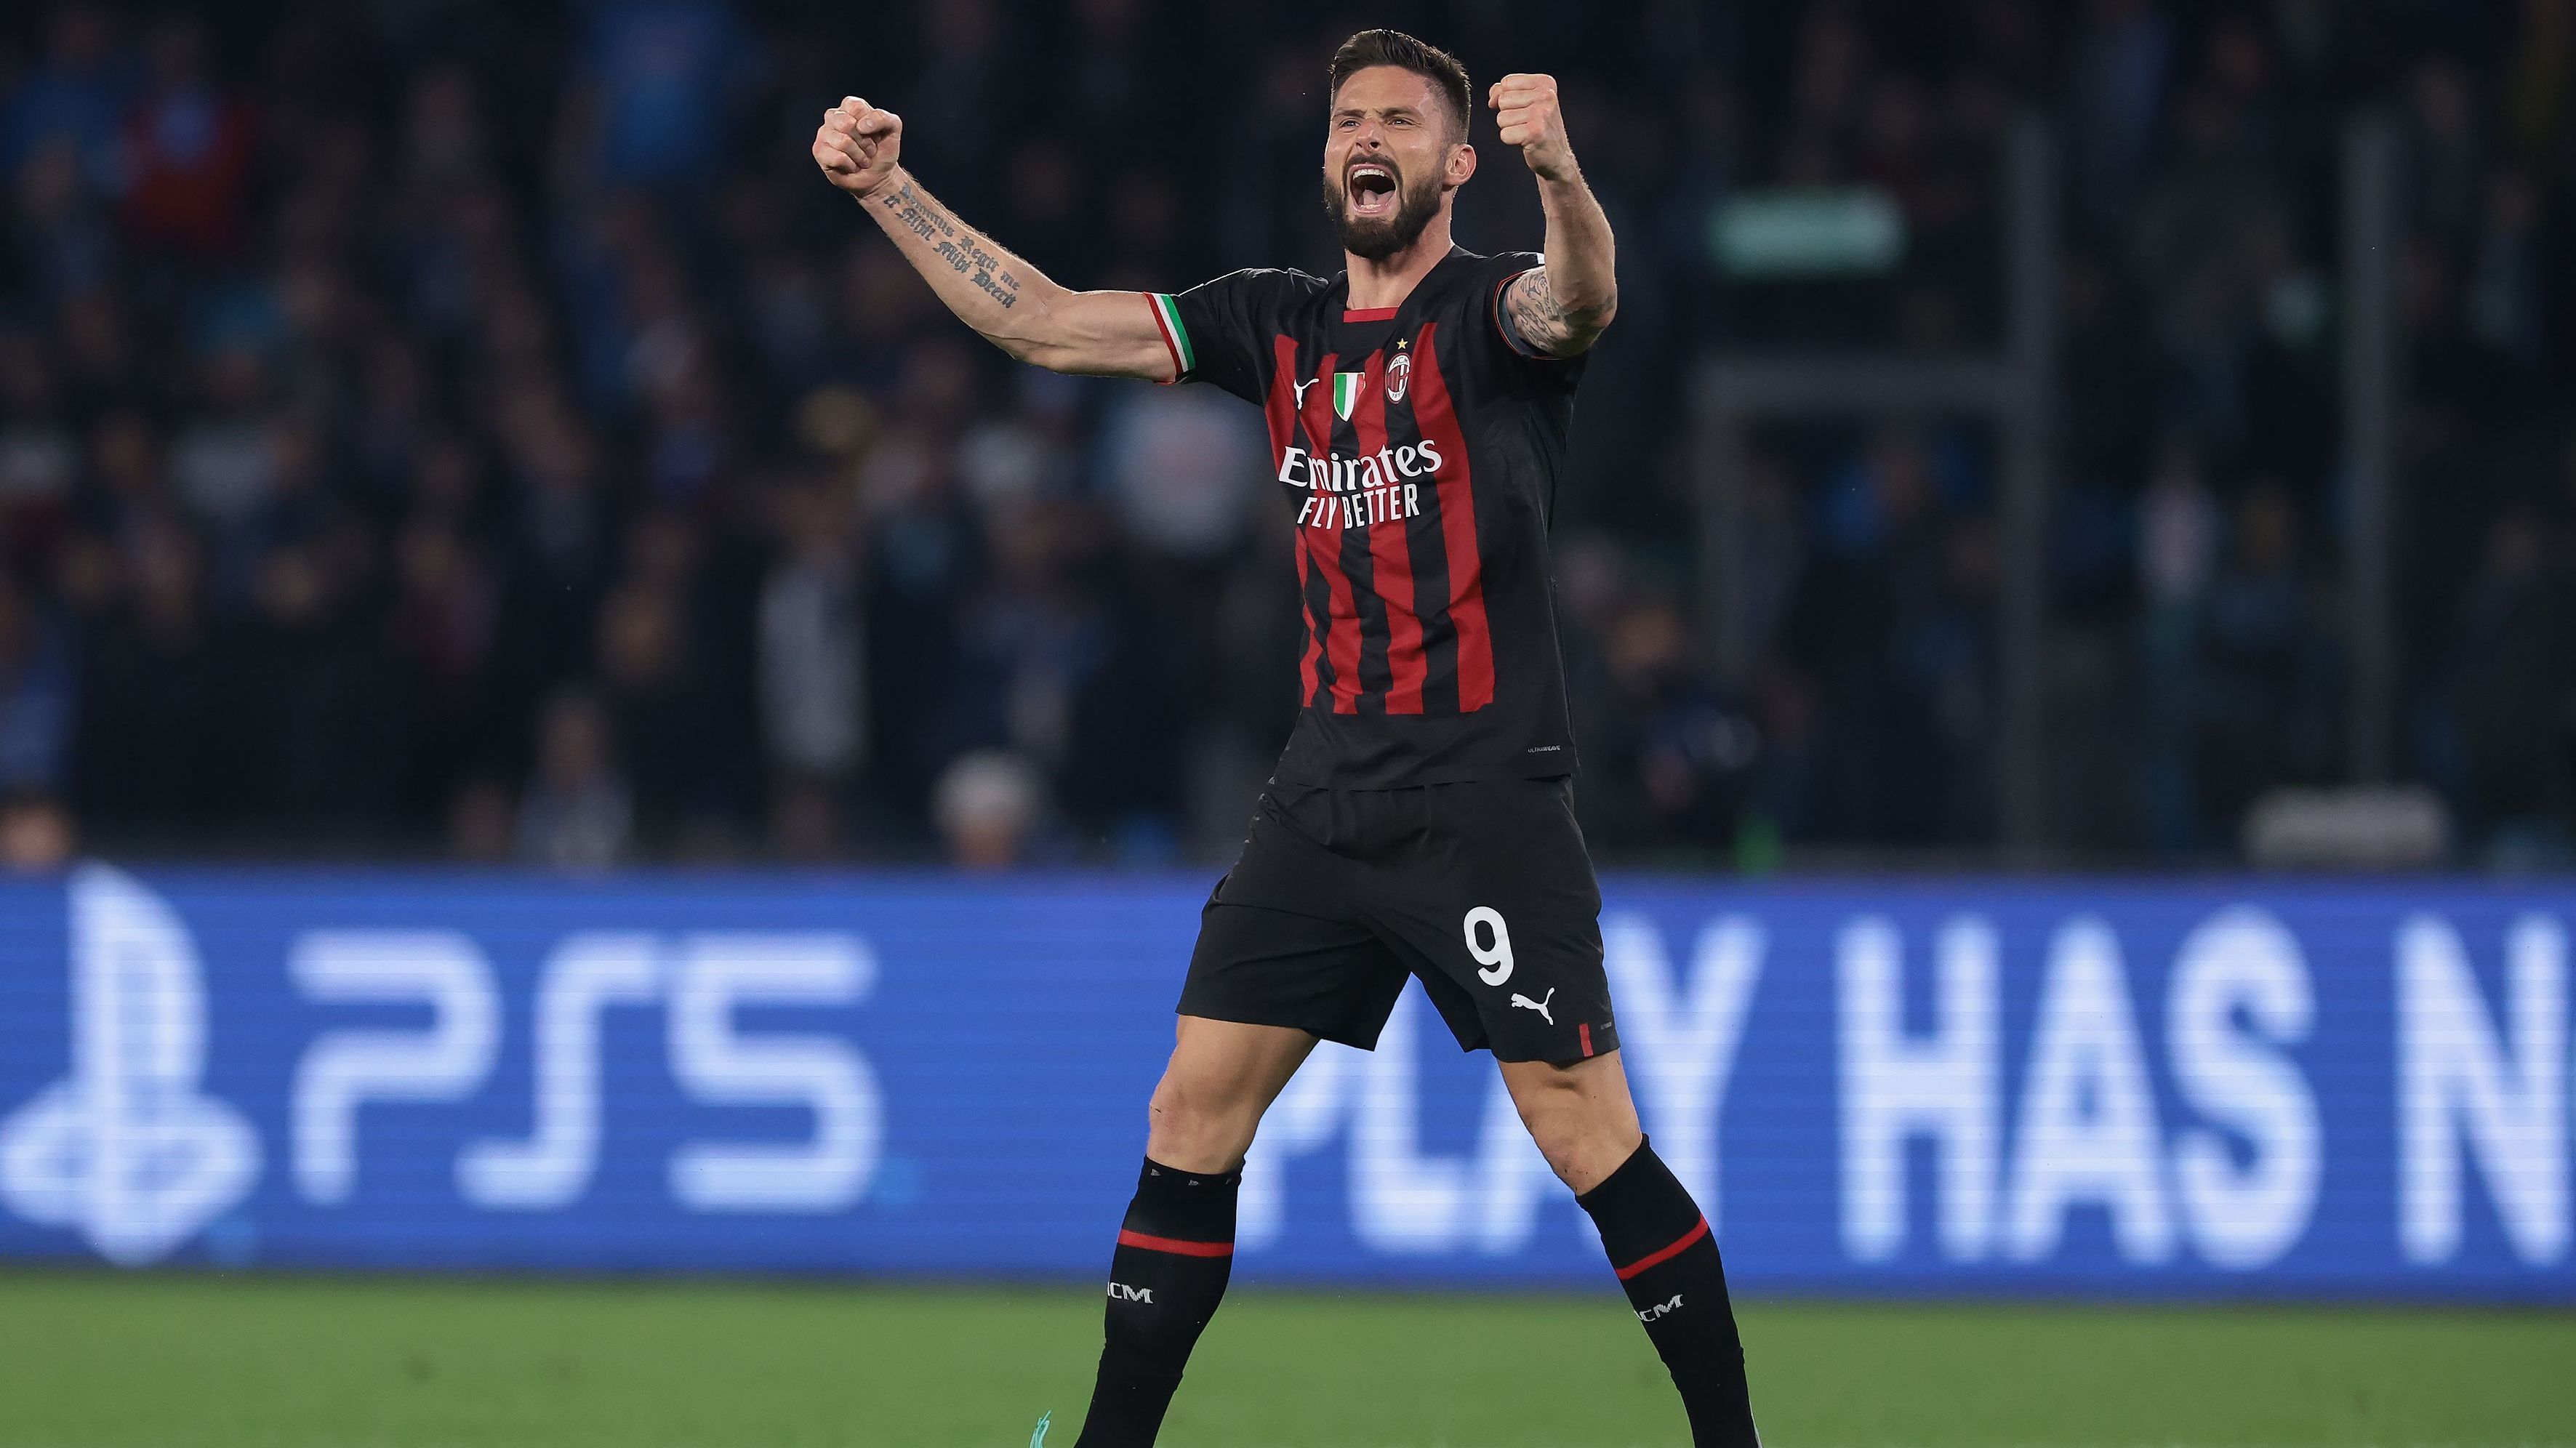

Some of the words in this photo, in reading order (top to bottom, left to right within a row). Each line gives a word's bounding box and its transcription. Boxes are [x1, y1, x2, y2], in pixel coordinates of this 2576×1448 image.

[958, 235, 1000, 273] Regit
[1000, 270, 1021, 291] me
[1392, 355, 1409, 368] ACM
[1278, 439, 1443, 493] Emirates
[1296, 496, 1338, 530] FLY
[1341, 483, 1420, 530] BETTER
[1463, 906, 1514, 986] 9
[285, 929, 886, 1212] PS5
[1832, 904, 2327, 1271] HAS
[1107, 1282, 1153, 1303] CM
[1634, 1295, 1683, 1322] CM
